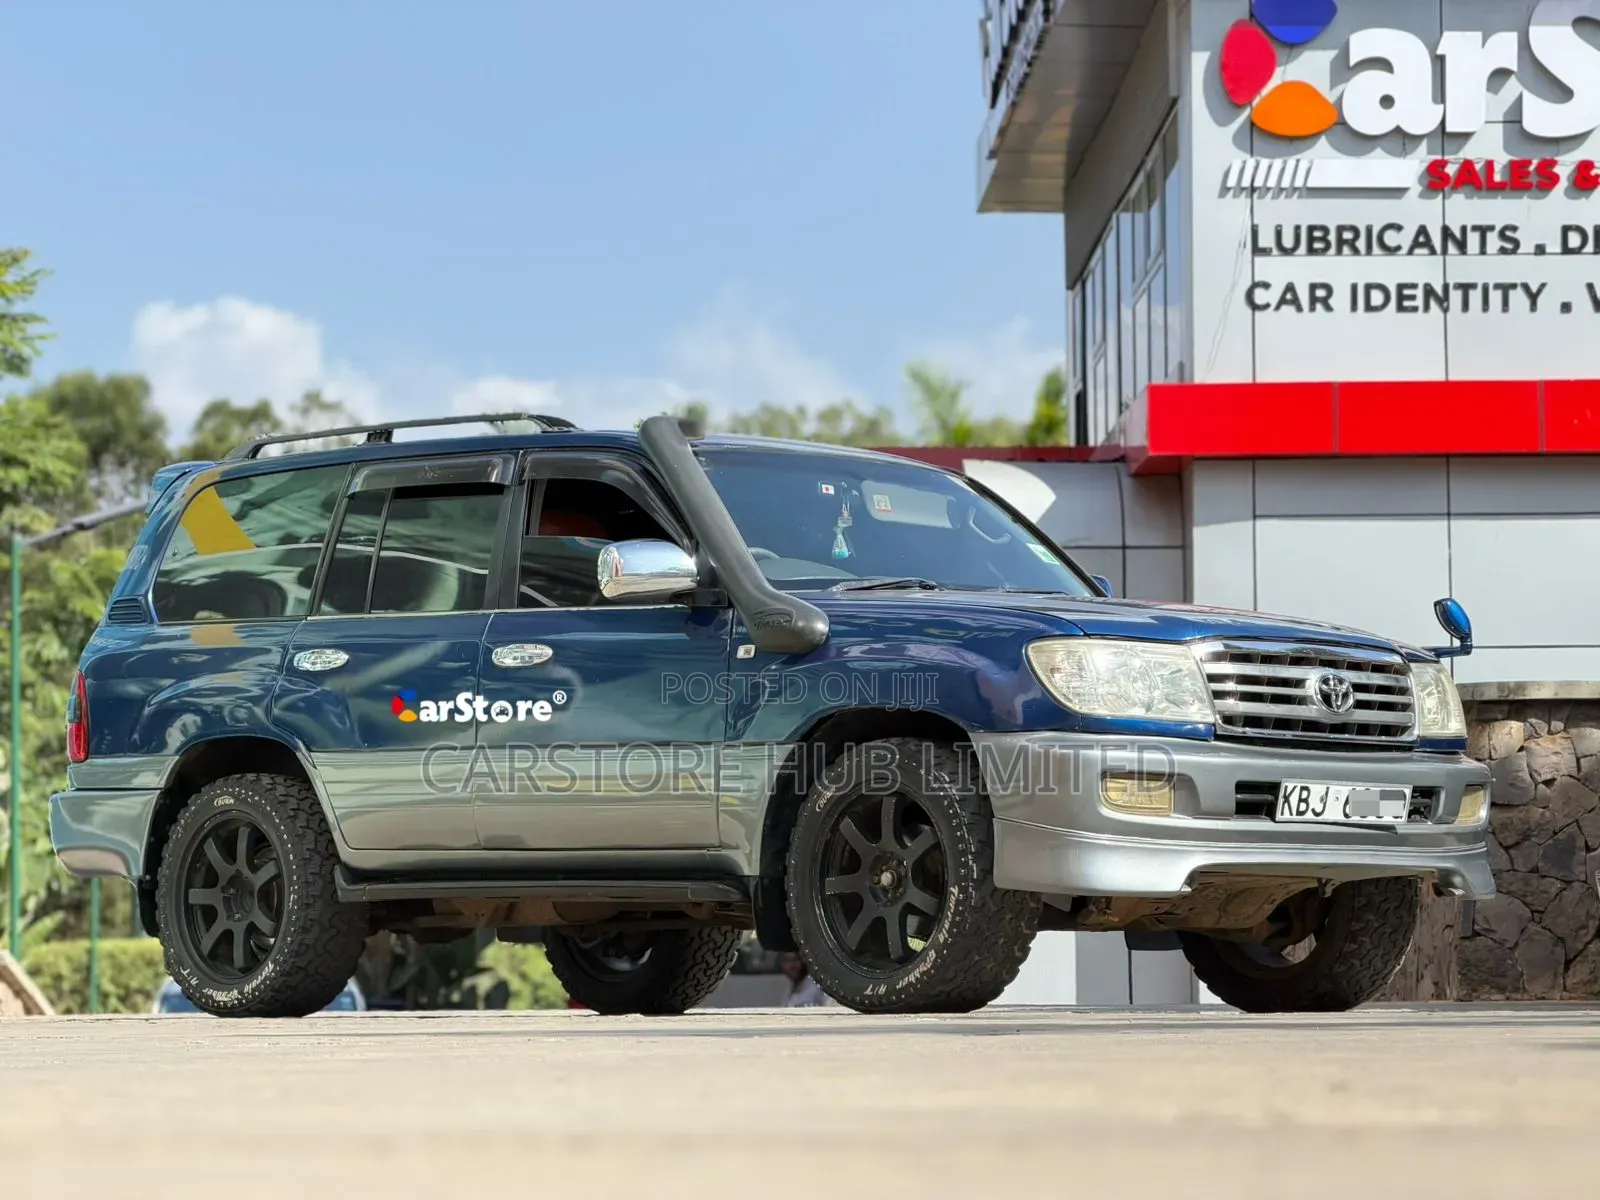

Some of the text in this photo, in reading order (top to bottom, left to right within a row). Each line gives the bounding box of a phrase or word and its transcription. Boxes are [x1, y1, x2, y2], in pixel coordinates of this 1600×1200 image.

[1426, 158, 1560, 191] SALES
[1251, 223, 1521, 256] LUBRICANTS
[1245, 280, 1334, 313] CAR
[1350, 282, 1548, 313] IDENTITY
[1280, 785, 1330, 817] KBJ
